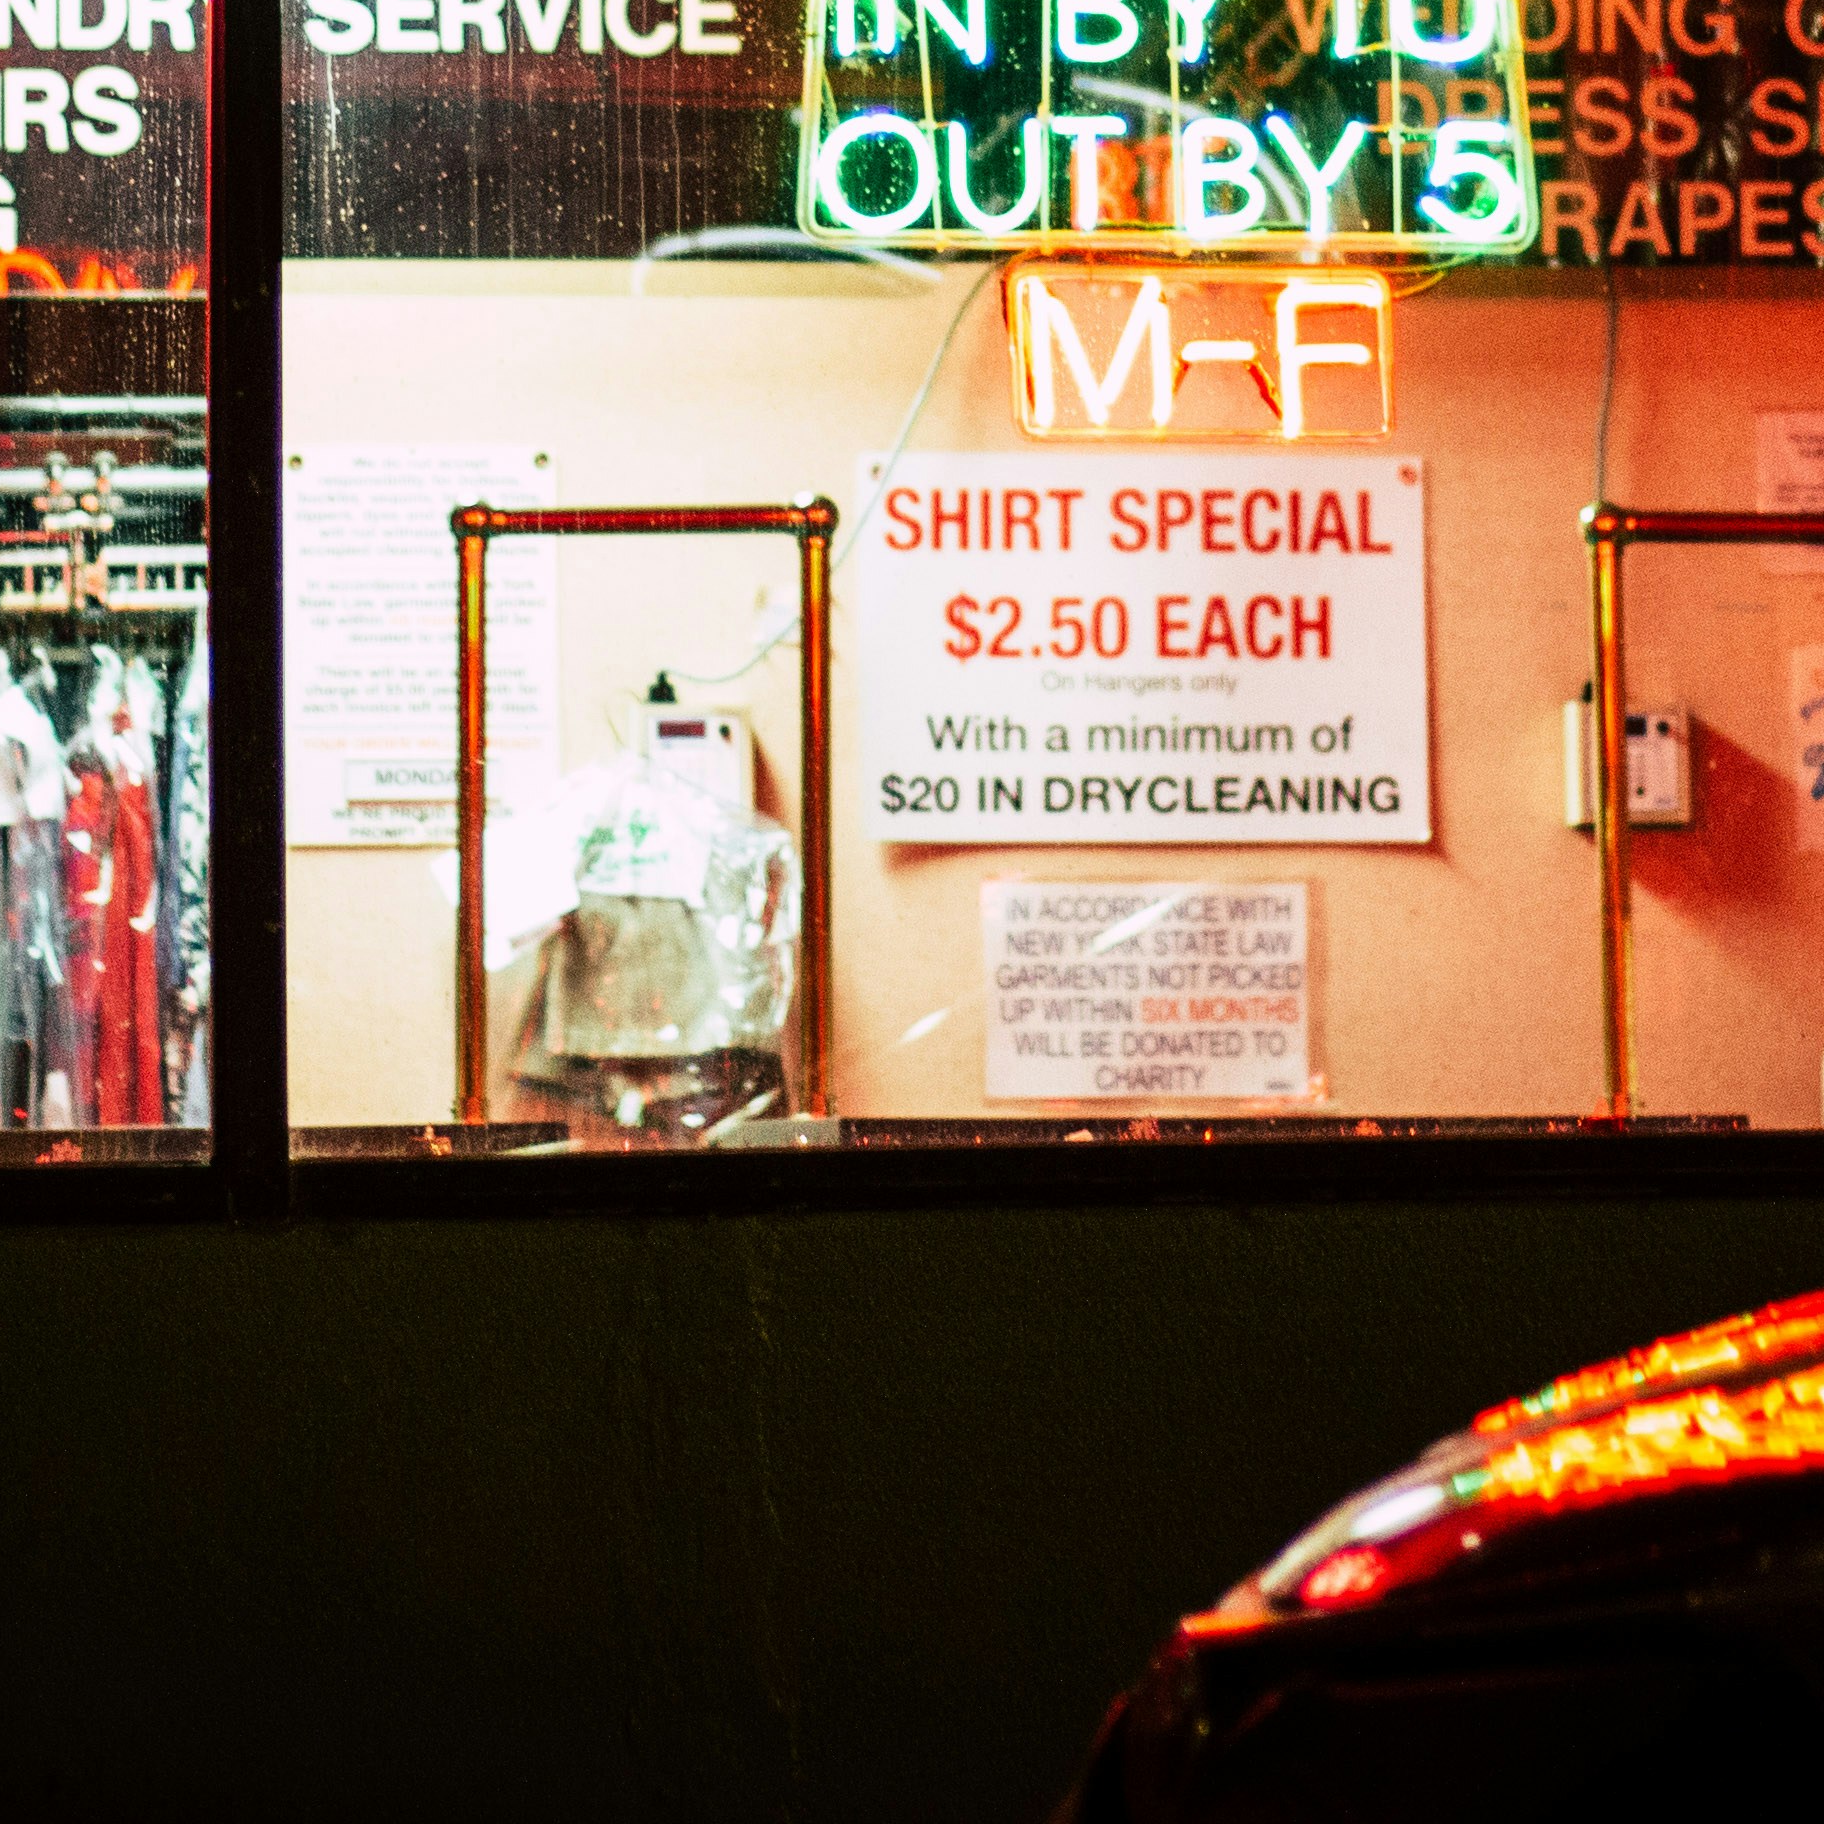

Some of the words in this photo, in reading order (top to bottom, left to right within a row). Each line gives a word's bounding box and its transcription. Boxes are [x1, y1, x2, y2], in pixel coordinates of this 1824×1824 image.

[819, 113, 1128, 234] OUT
[1181, 114, 1368, 240] BY
[1419, 120, 1520, 240] 5
[1024, 274, 1384, 439] M-F
[883, 486, 1085, 552] SHIRT
[1108, 487, 1394, 556] SPECIAL
[942, 590, 1131, 665] $2.50
[1154, 593, 1333, 660] EACH
[1041, 671, 1075, 693] On
[1083, 671, 1184, 698] Hangers
[1189, 671, 1238, 697] only
[926, 714, 1028, 754] With
[1044, 725, 1070, 754] a
[1086, 714, 1295, 755] minimum
[1309, 714, 1356, 755] of
[374, 767, 460, 786] MONDA
[880, 774, 961, 815] $20
[976, 775, 1025, 814] IN
[1043, 776, 1402, 815] DRYCLEANING
[1007, 895, 1029, 923] IN
[1226, 895, 1294, 923] WITH
[1007, 928, 1065, 957] NEW
[1153, 928, 1229, 957] STATE
[1237, 928, 1295, 957] LAW
[995, 962, 1140, 991] GARMENTS
[1148, 962, 1202, 991] NOT
[1208, 962, 1304, 991] PICKED
[998, 996, 1035, 1024] UP
[1043, 996, 1133, 1024] WITHIN
[1140, 996, 1181, 1024] SIX
[1187, 996, 1300, 1024] MONTHS
[1014, 1029, 1073, 1059] WILL
[1079, 1029, 1113, 1059] BE
[1121, 1029, 1246, 1059] DONATED
[1252, 1029, 1288, 1059] TO
[1094, 1063, 1210, 1091] CHARITY
